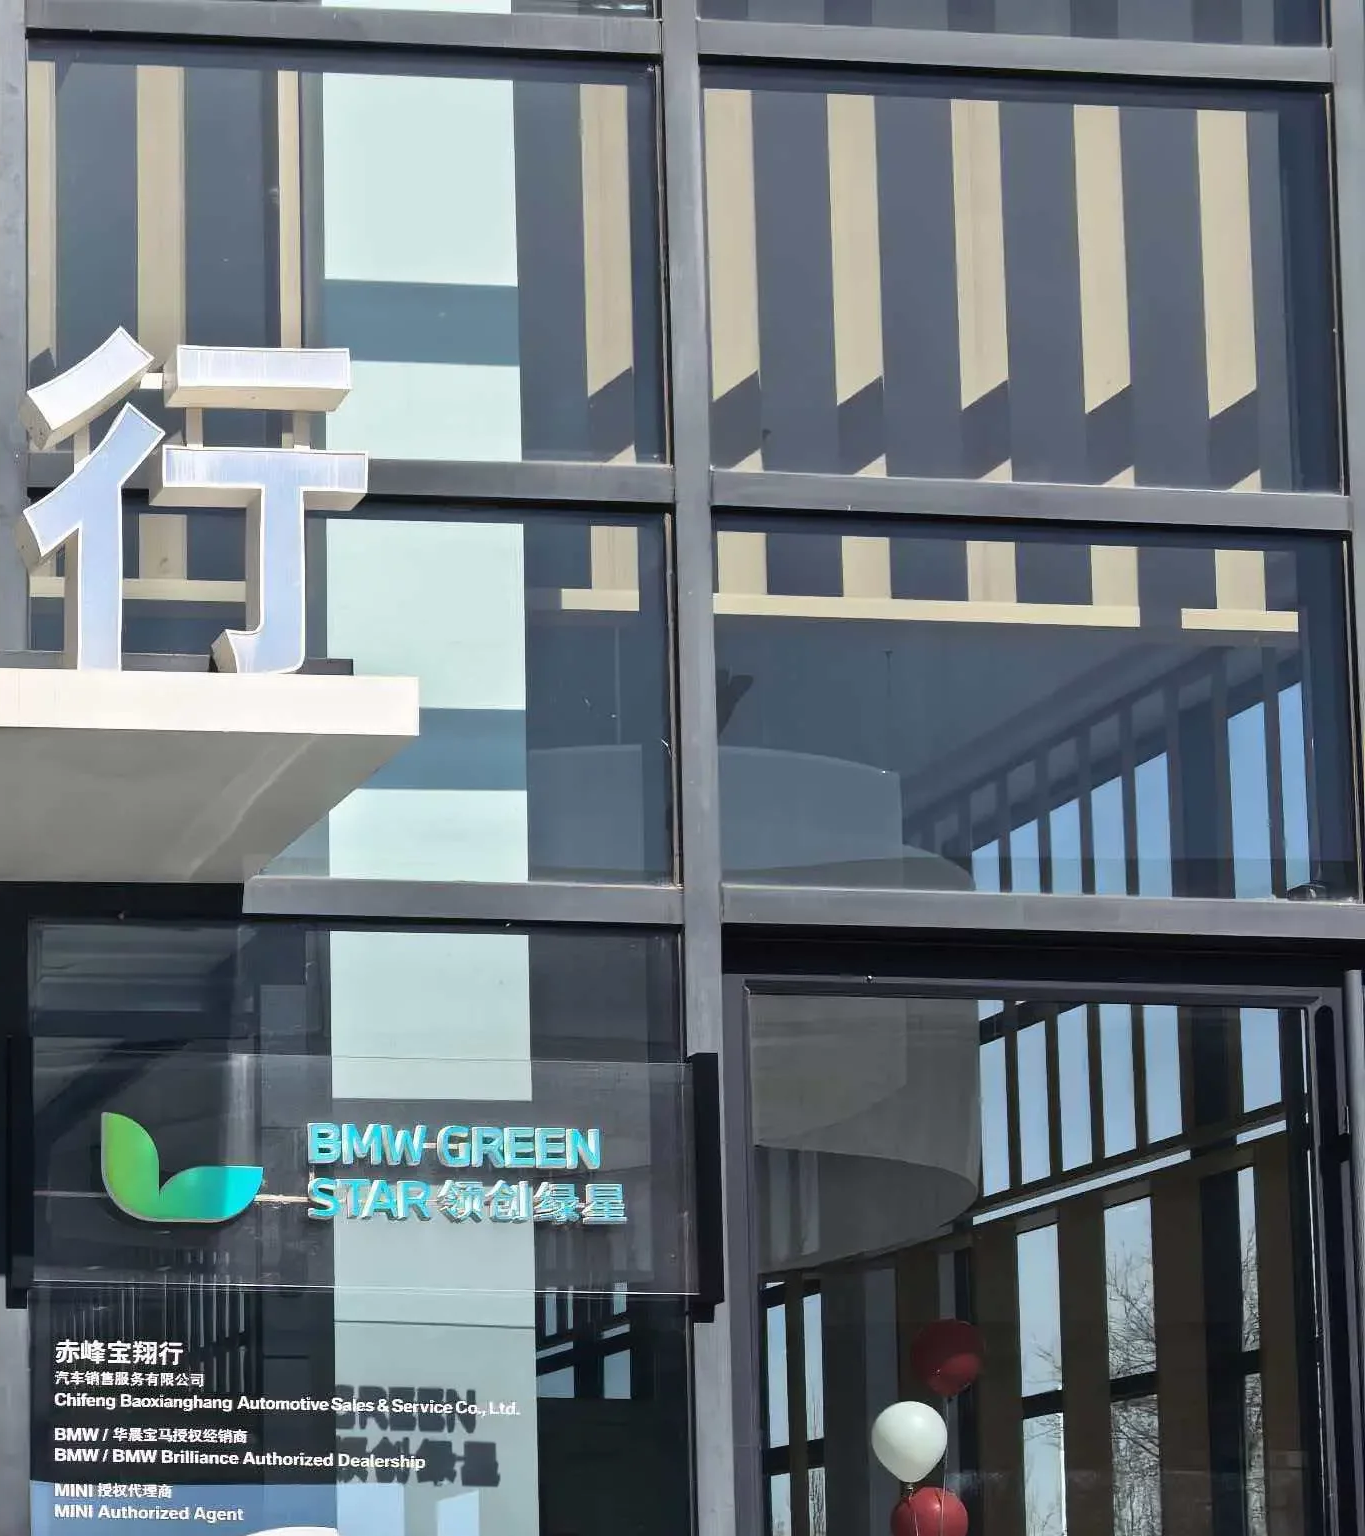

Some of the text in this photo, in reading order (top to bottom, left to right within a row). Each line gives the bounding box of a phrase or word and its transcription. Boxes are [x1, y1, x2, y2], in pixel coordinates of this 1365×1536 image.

[307, 1122, 602, 1169] BMW GREEN
[307, 1178, 628, 1225] STAR 领创绿星
[54, 1340, 184, 1366] 赤峰宝翔行
[54, 1371, 206, 1388] 汽车销售服务有限公司
[54, 1392, 116, 1411] Chifeng
[120, 1394, 233, 1413] Baoxianghang
[237, 1395, 328, 1411] Automotive
[331, 1397, 375, 1412] Sales
[377, 1398, 389, 1412] &
[391, 1398, 453, 1414] Service
[489, 1401, 520, 1416] Ltd.
[54, 1427, 99, 1442] BMW
[112, 1428, 248, 1444] 华晨宝马授权经销商
[54, 1448, 99, 1462] BMW
[112, 1449, 157, 1463] BMW
[161, 1450, 240, 1465] Brilliance
[242, 1451, 334, 1467] Authorized
[337, 1453, 427, 1472] Dealership
[54, 1483, 174, 1499] MINI 授权代理商
[54, 1503, 245, 1524] MINI Authorized Agent
